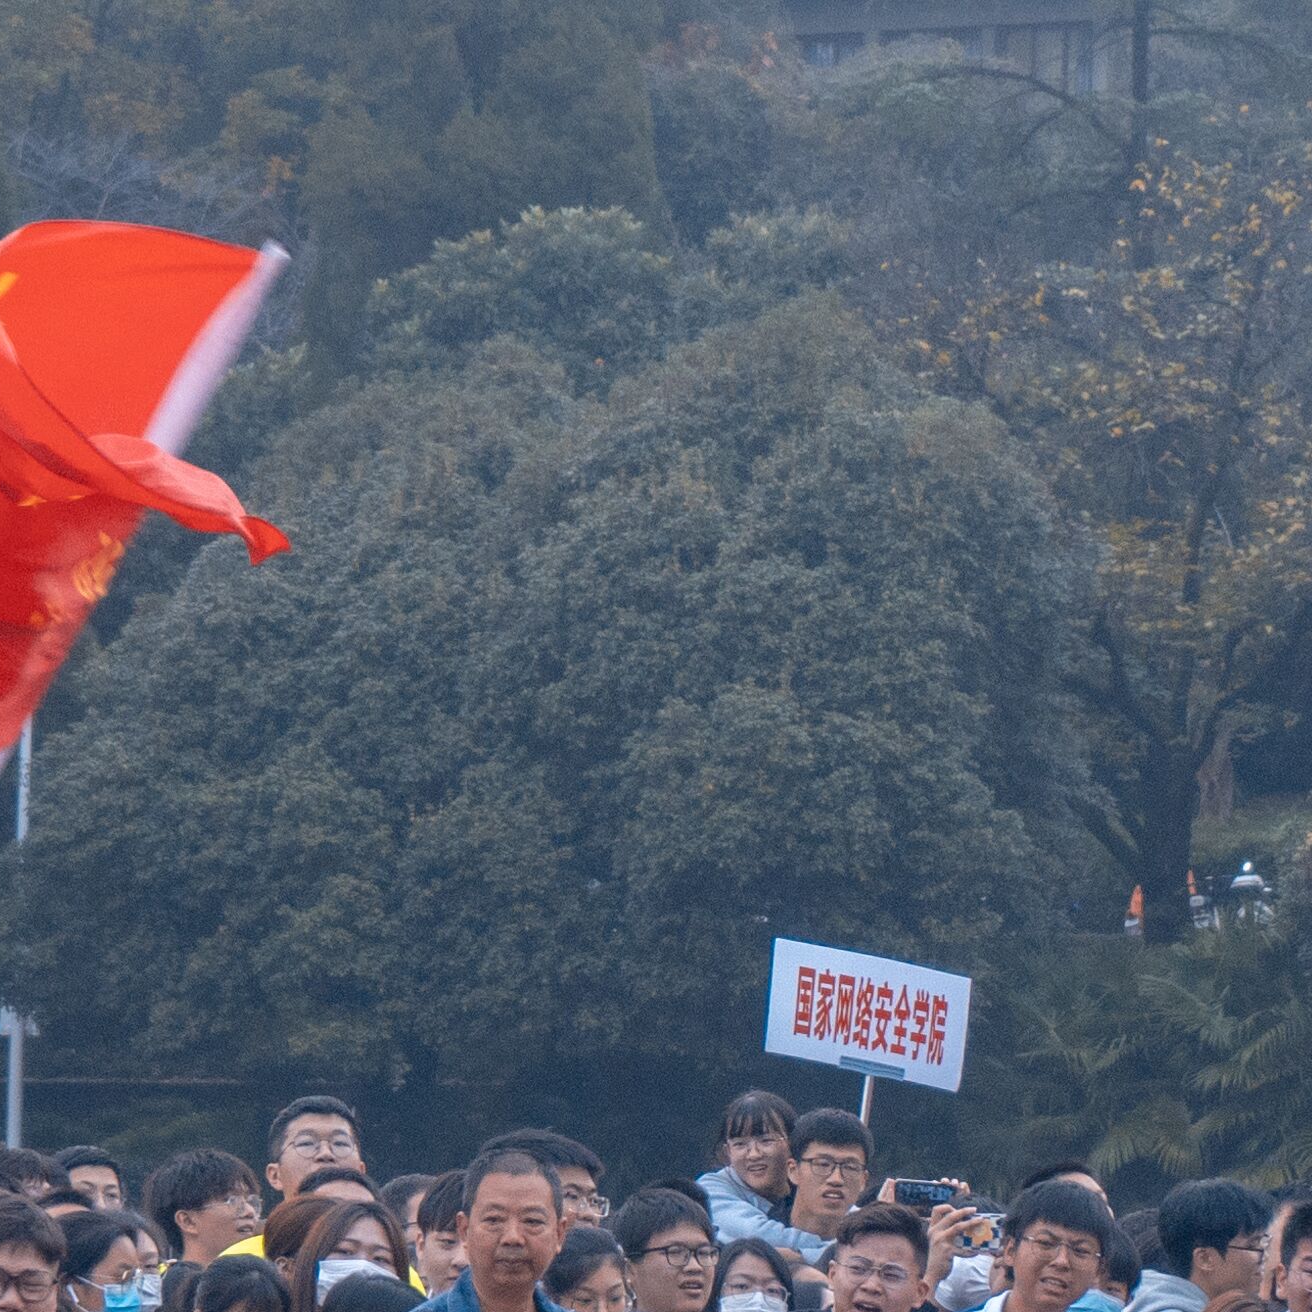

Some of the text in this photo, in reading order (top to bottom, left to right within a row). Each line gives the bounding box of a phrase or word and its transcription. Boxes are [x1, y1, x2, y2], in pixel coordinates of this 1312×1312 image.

[793, 966, 949, 1066] 国家网络安全学院
